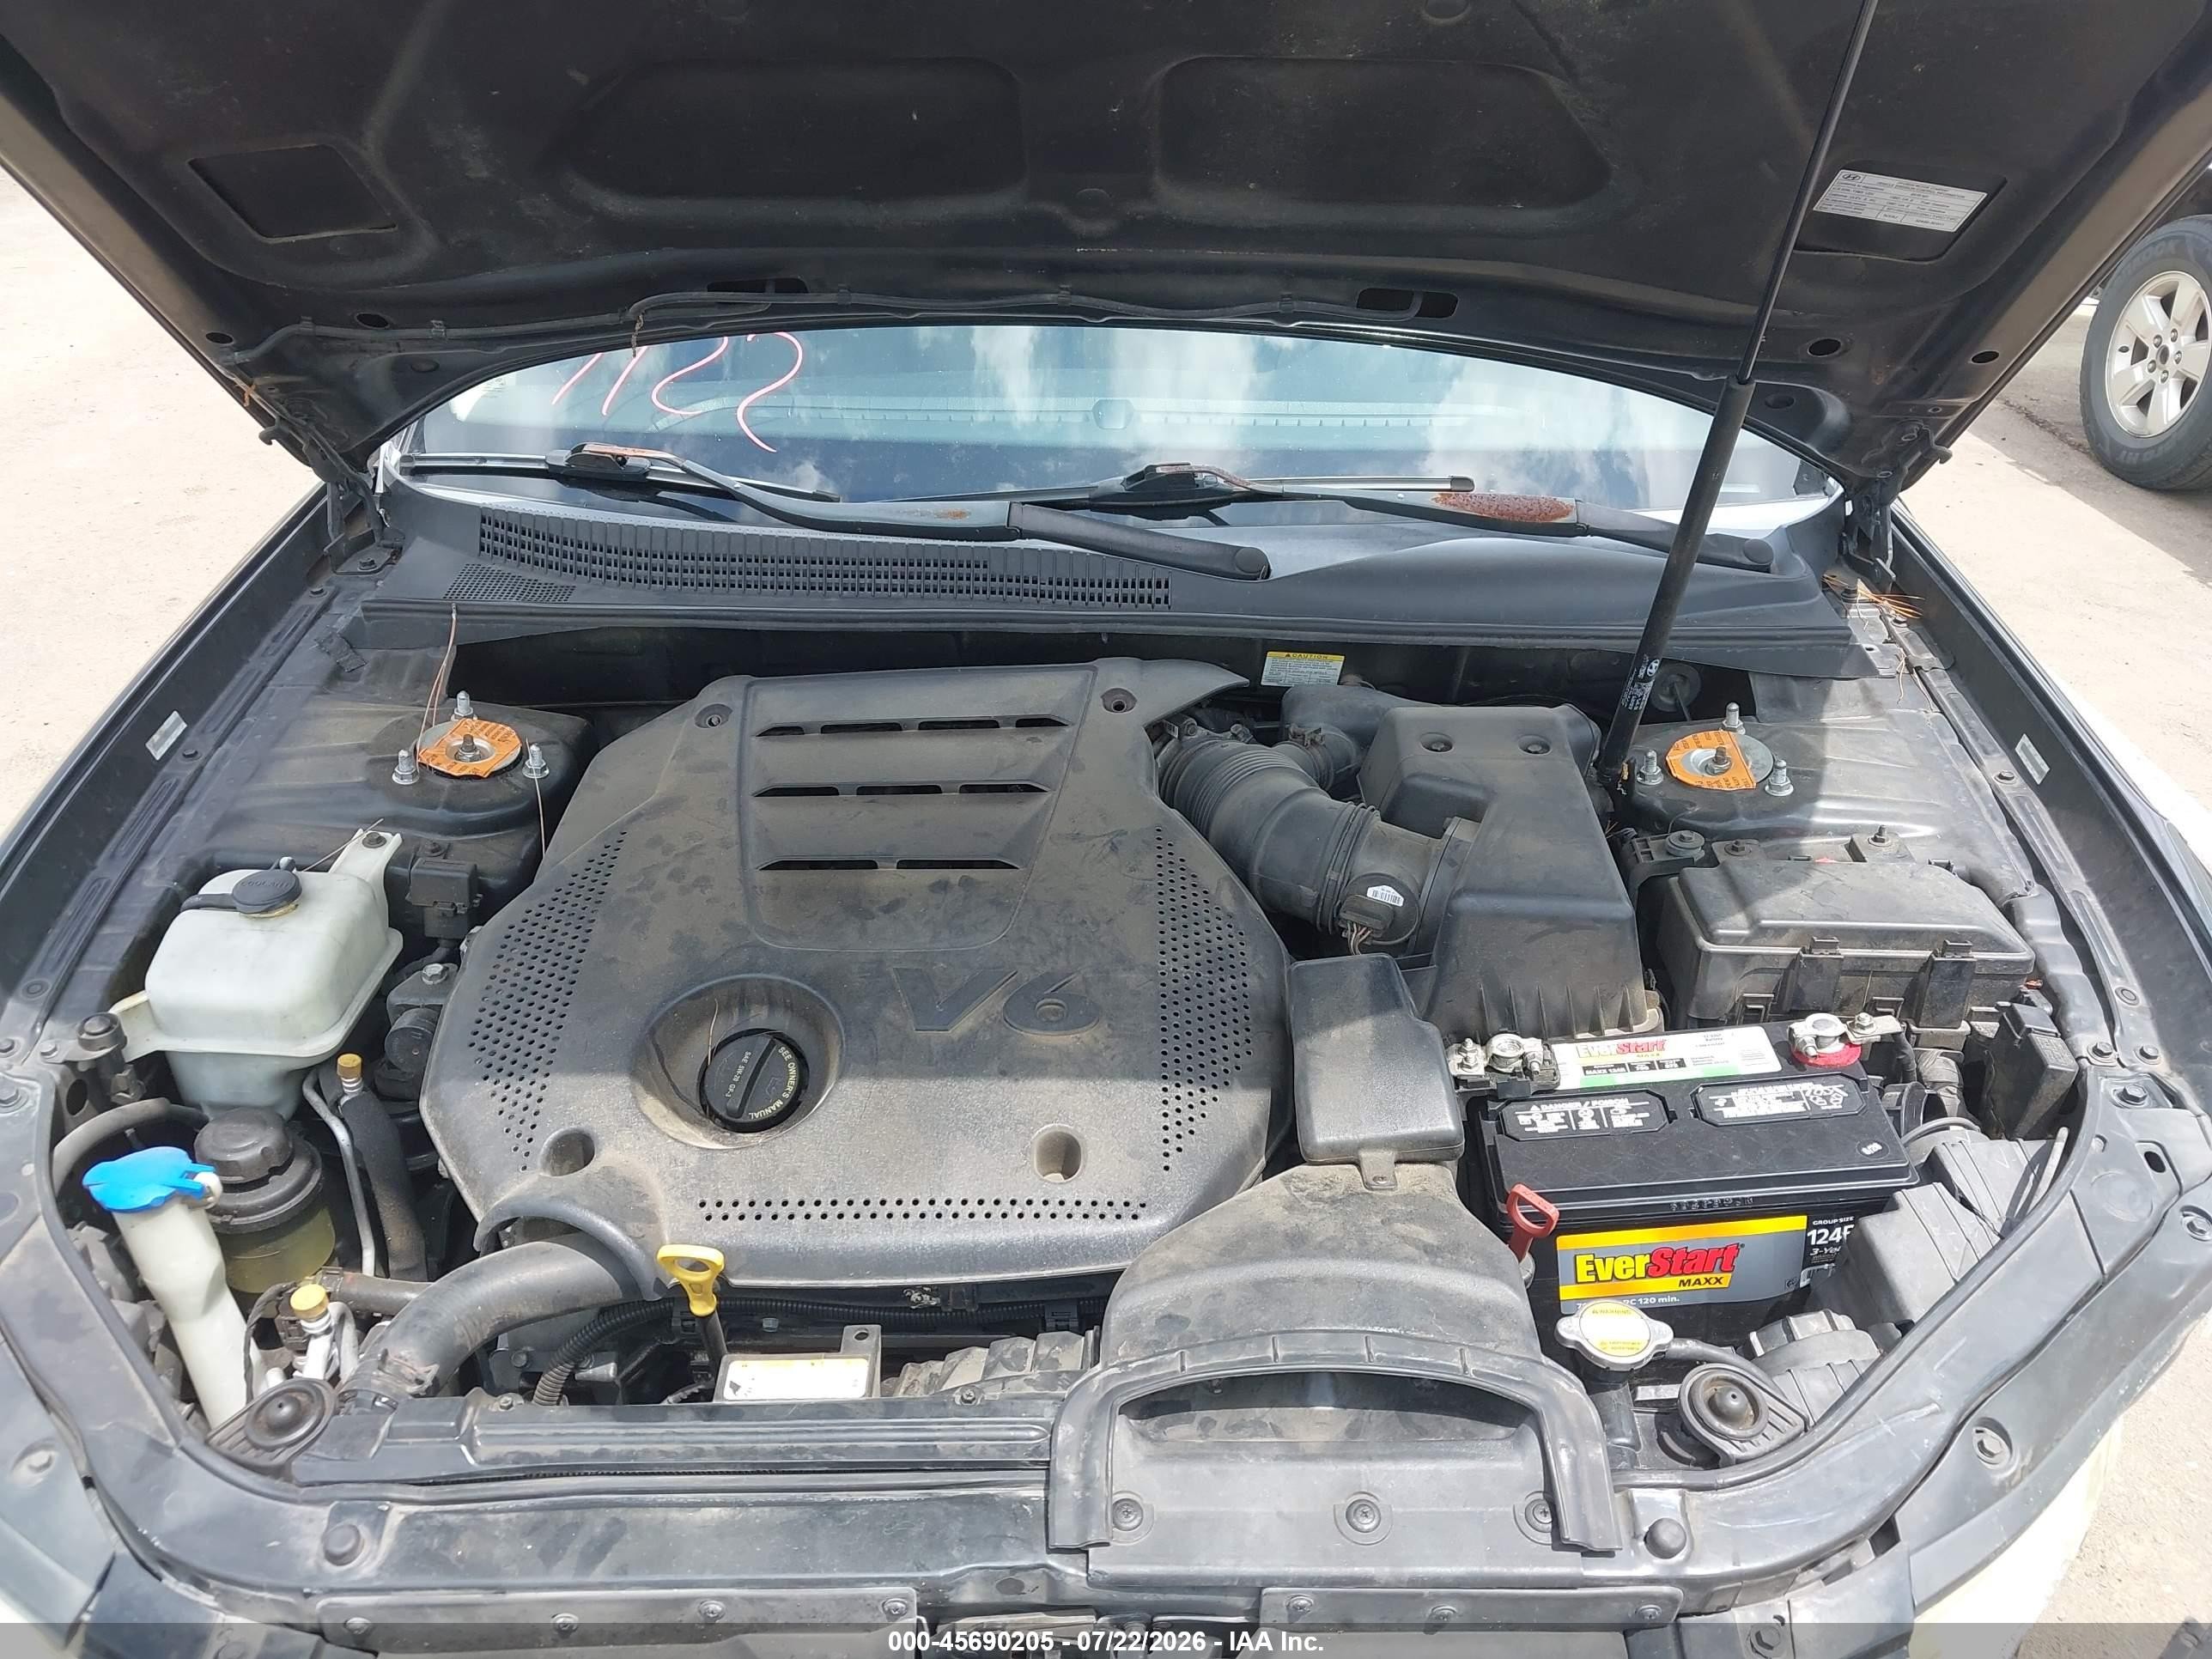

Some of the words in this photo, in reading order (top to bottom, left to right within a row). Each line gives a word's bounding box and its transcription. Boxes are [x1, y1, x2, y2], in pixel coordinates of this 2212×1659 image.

[240, 880, 290, 889] COOLANT
[892, 967, 1103, 1036] V6
[777, 1046, 792, 1061] SEE
[1577, 1039, 1666, 1059] EverStart
[741, 1051, 752, 1064] SAE
[733, 1065, 745, 1082] 5W-20
[781, 1062, 799, 1099] OWNER'S
[748, 1098, 784, 1120] MANUAL
[1540, 1102, 1583, 1111] DANGER
[1592, 1098, 1630, 1107] POISON
[1809, 1245, 1842, 1256] 3-Yea
[1575, 1243, 1741, 1285] EverStart
[1678, 1276, 1724, 1288] MAXX
[1638, 1297, 1657, 1305] 120
[1657, 1295, 1680, 1304] min.
